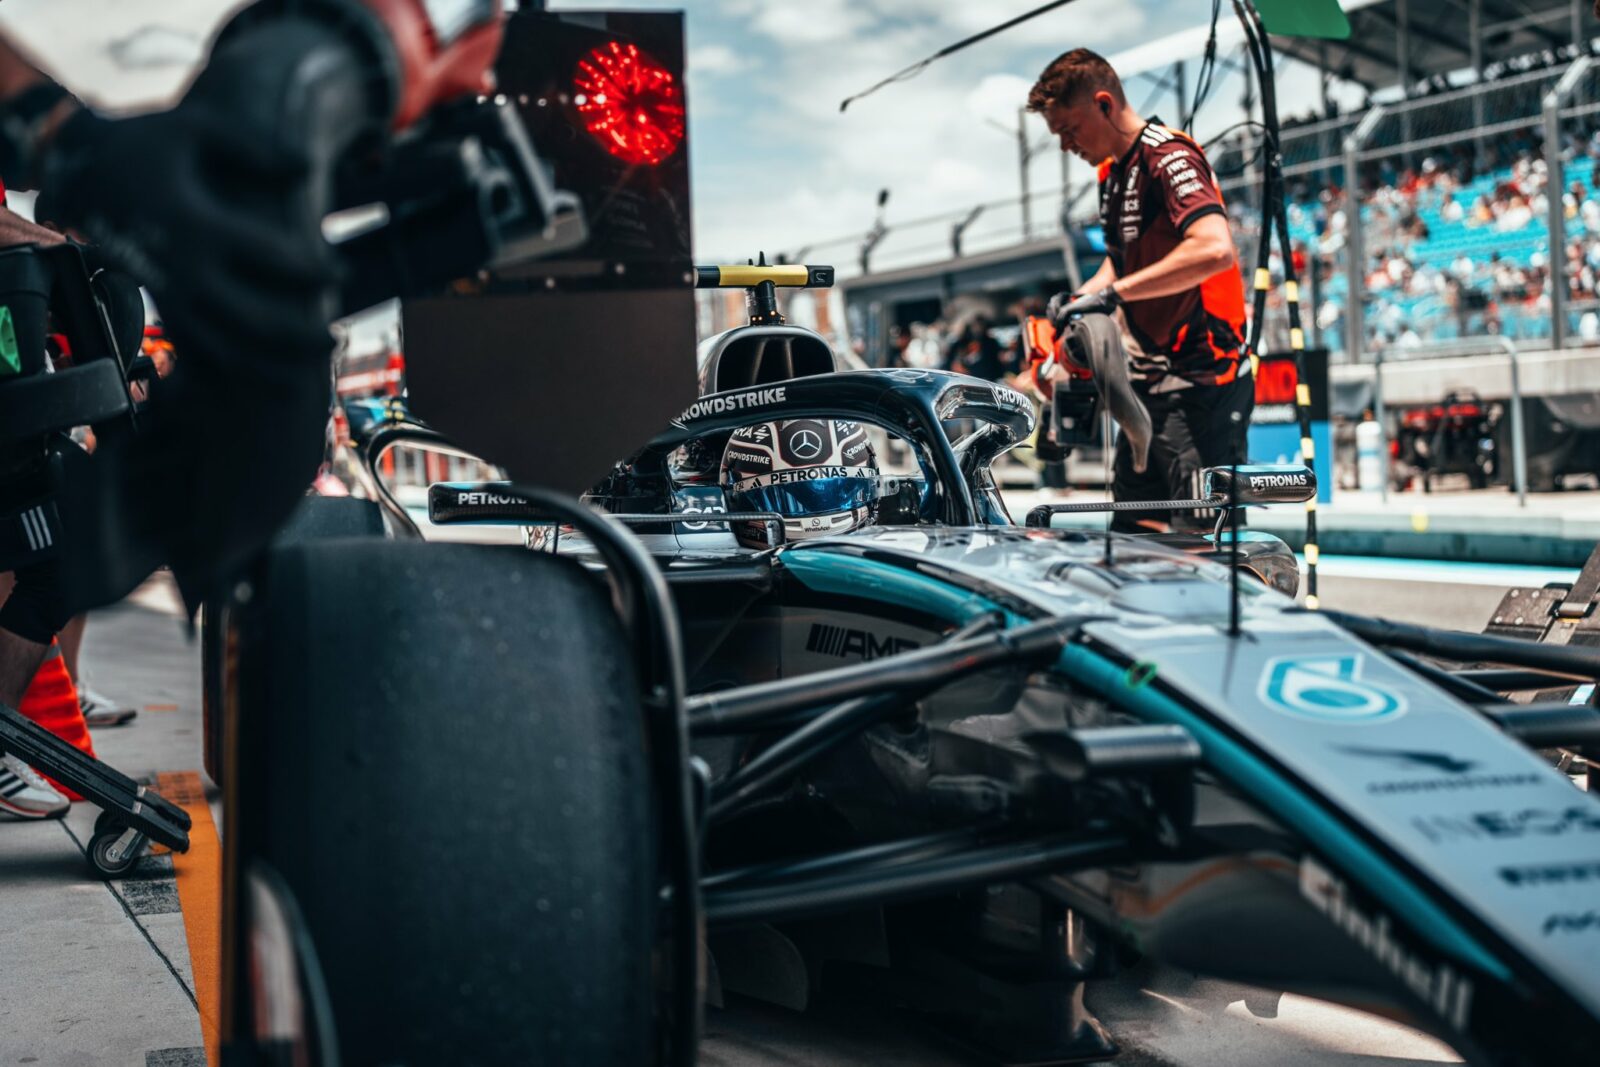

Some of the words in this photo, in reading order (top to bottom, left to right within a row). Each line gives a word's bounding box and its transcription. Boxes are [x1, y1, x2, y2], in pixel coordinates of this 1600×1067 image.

[770, 466, 848, 485] PETRONAS
[1249, 474, 1307, 488] PETRONAS
[458, 492, 528, 505] PETRO
[804, 525, 831, 533] WhatsApp
